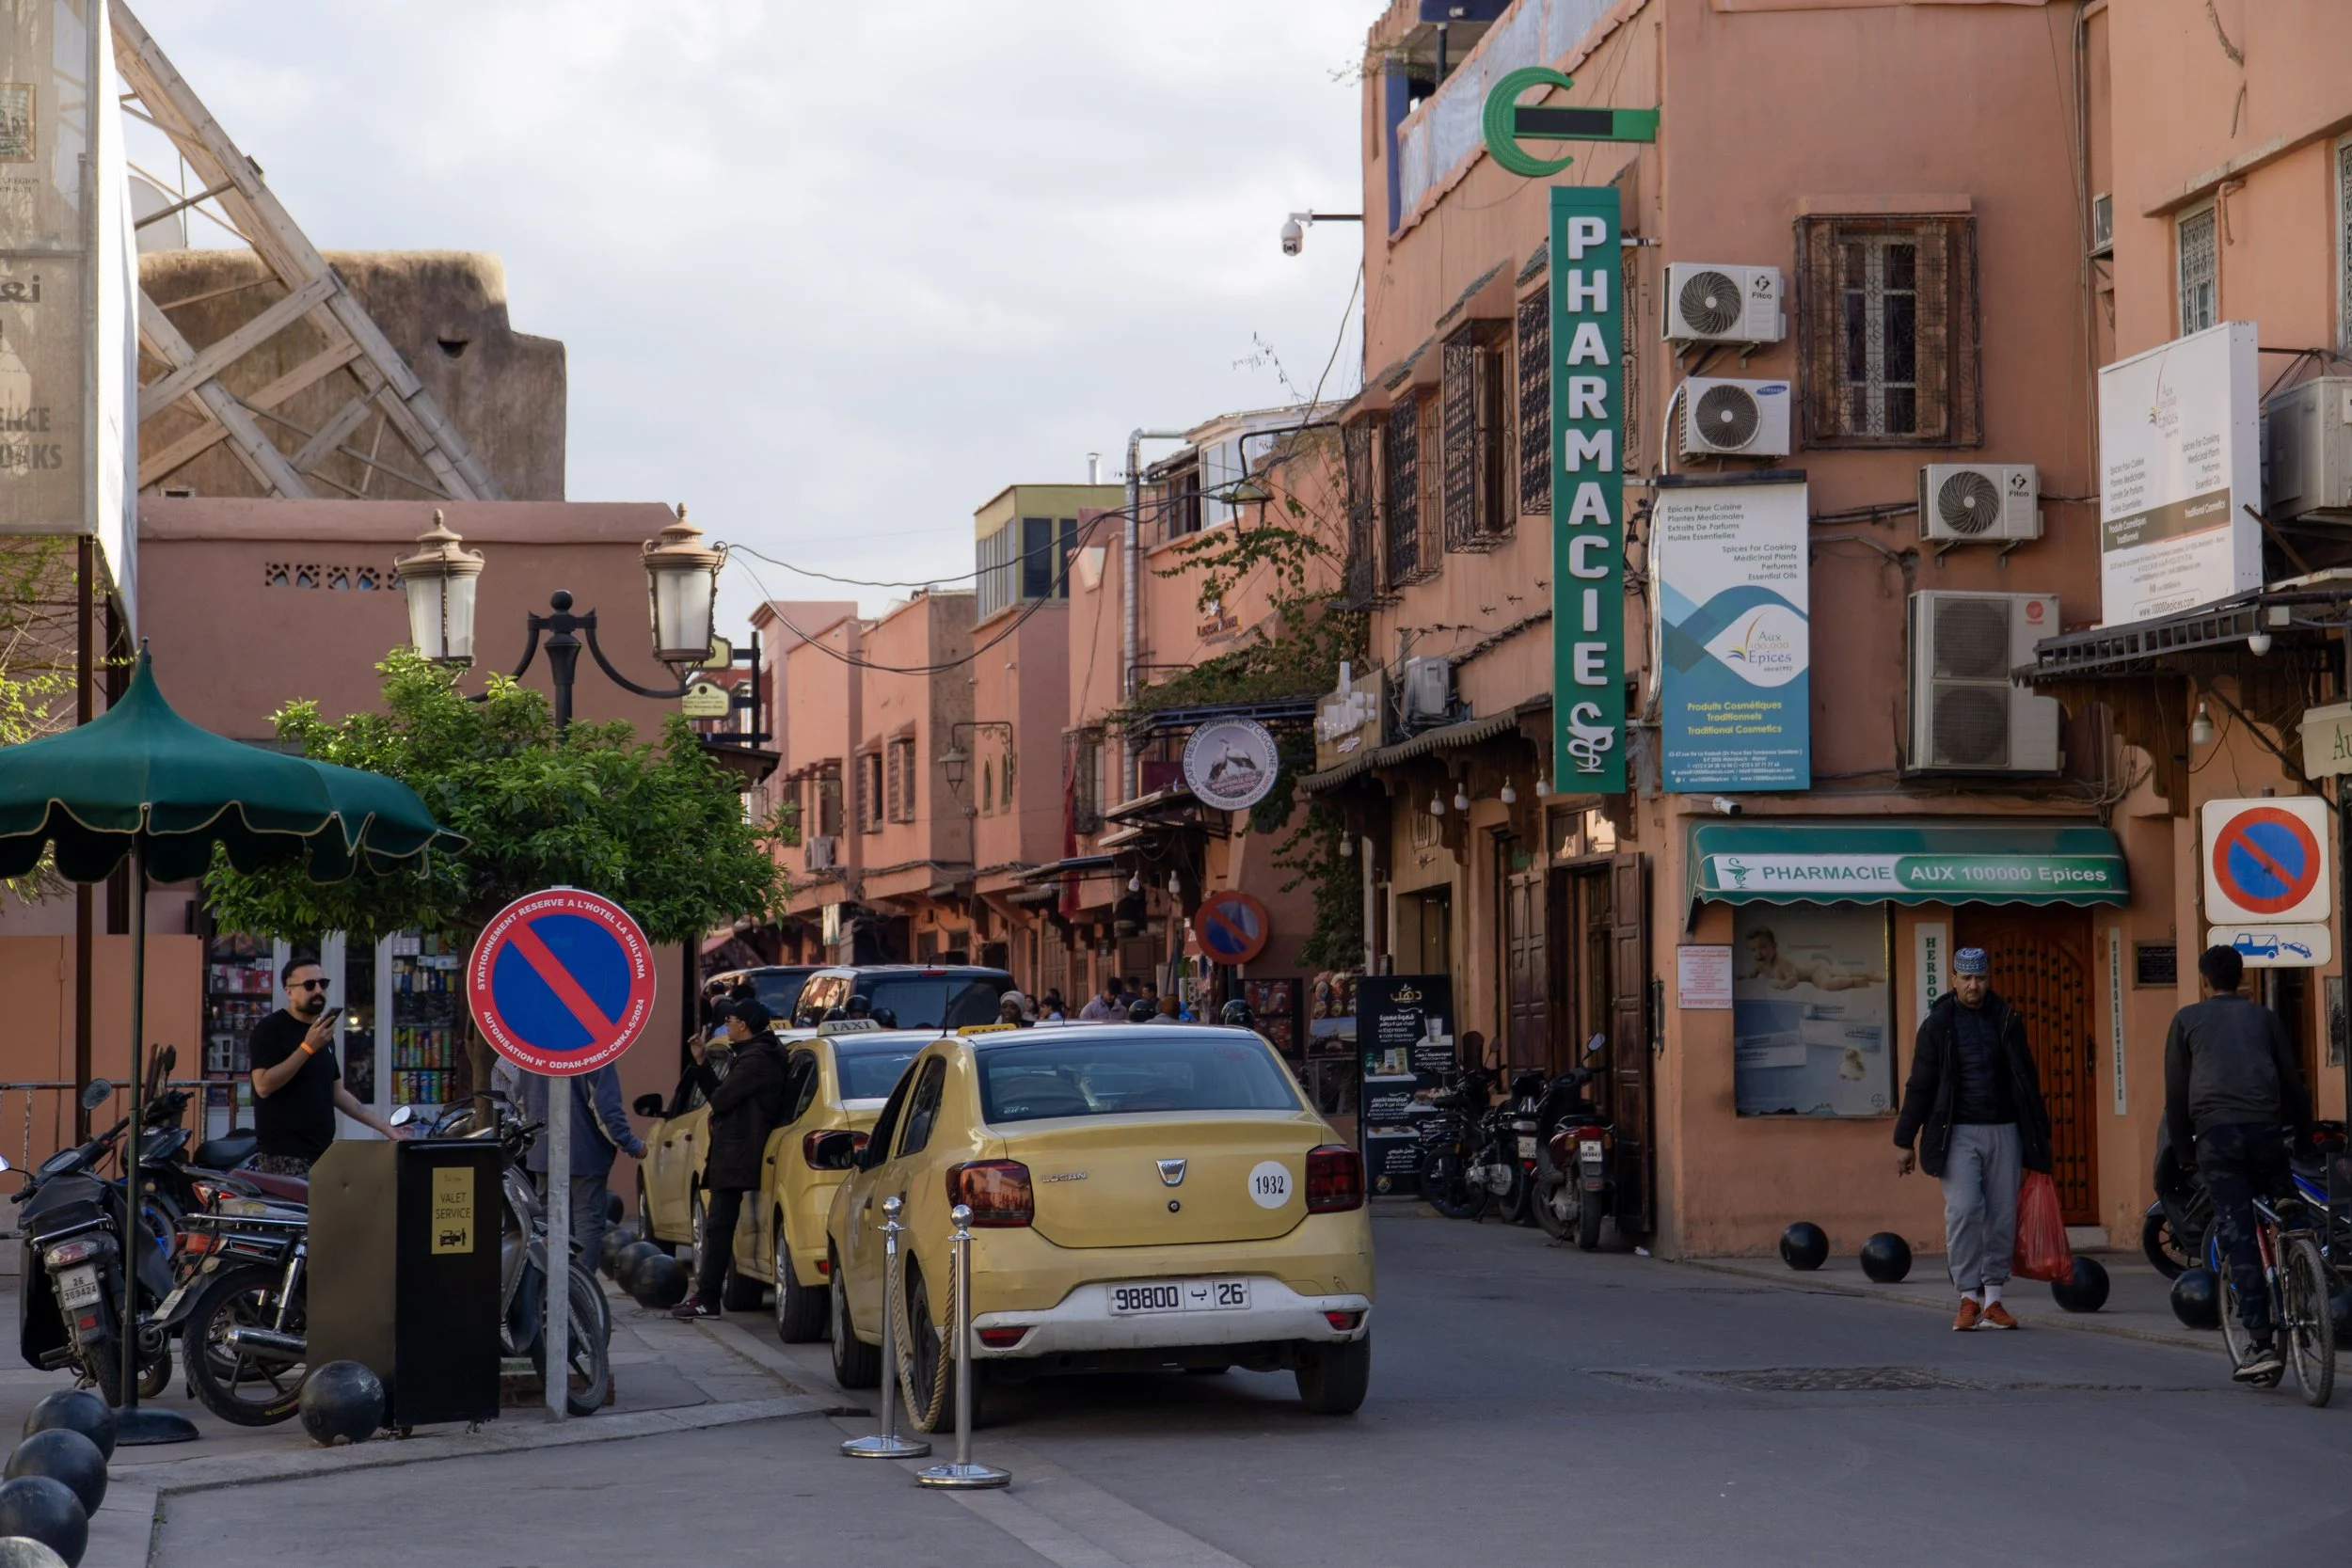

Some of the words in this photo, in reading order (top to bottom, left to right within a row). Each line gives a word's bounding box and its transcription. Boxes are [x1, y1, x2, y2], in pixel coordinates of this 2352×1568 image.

[1565, 216, 1613, 686] PHARMACIE
[1692, 532, 1735, 541] Essentielles
[1763, 543, 1797, 551] Cooking
[1734, 553, 1772, 562] Medicinal
[1761, 562, 1797, 571] Perfumes
[1748, 572, 1781, 580] Essential
[1757, 631, 1782, 641] Aux
[1749, 650, 1792, 666] Epices
[1687, 703, 1722, 711] Produits
[1724, 701, 1782, 711] Cosmétiques
[1707, 712, 1761, 721] Traditionnels
[1687, 726, 1733, 735] Traditional
[1735, 725, 1782, 734] Cosmetics
[1185, 718, 1235, 759] RESTAURANT
[1184, 759, 1199, 786] CAFE
[1200, 789, 1216, 803] VOIR
[1215, 798, 1237, 806] GUIDE
[1248, 775, 1272, 803] ROUTARD
[1762, 864, 1892, 881] PHARMACIE
[1910, 867, 1955, 881] AUX
[1961, 866, 2032, 881] 100000
[2038, 867, 2107, 884] Epices
[477, 912, 517, 990] STATIONNEMENT
[518, 898, 564, 916] RESERVE
[567, 899, 575, 908] A
[577, 900, 616, 924] L'HOTEL
[615, 921, 628, 935] LA
[625, 933, 645, 980] SULTANA
[828, 1021, 871, 1032] TAXI
[483, 1010, 534, 1064] AUTORISATION
[1041, 1172, 1088, 1182] LOGAN
[1256, 1175, 1284, 1195] 1932
[439, 1192, 467, 1203] VALET
[436, 1208, 471, 1219] SERVICE
[72, 1276, 84, 1287] 26
[1116, 1286, 1179, 1310] 98800
[1190, 1290, 1207, 1301] ب
[1217, 1283, 1244, 1306] 26
